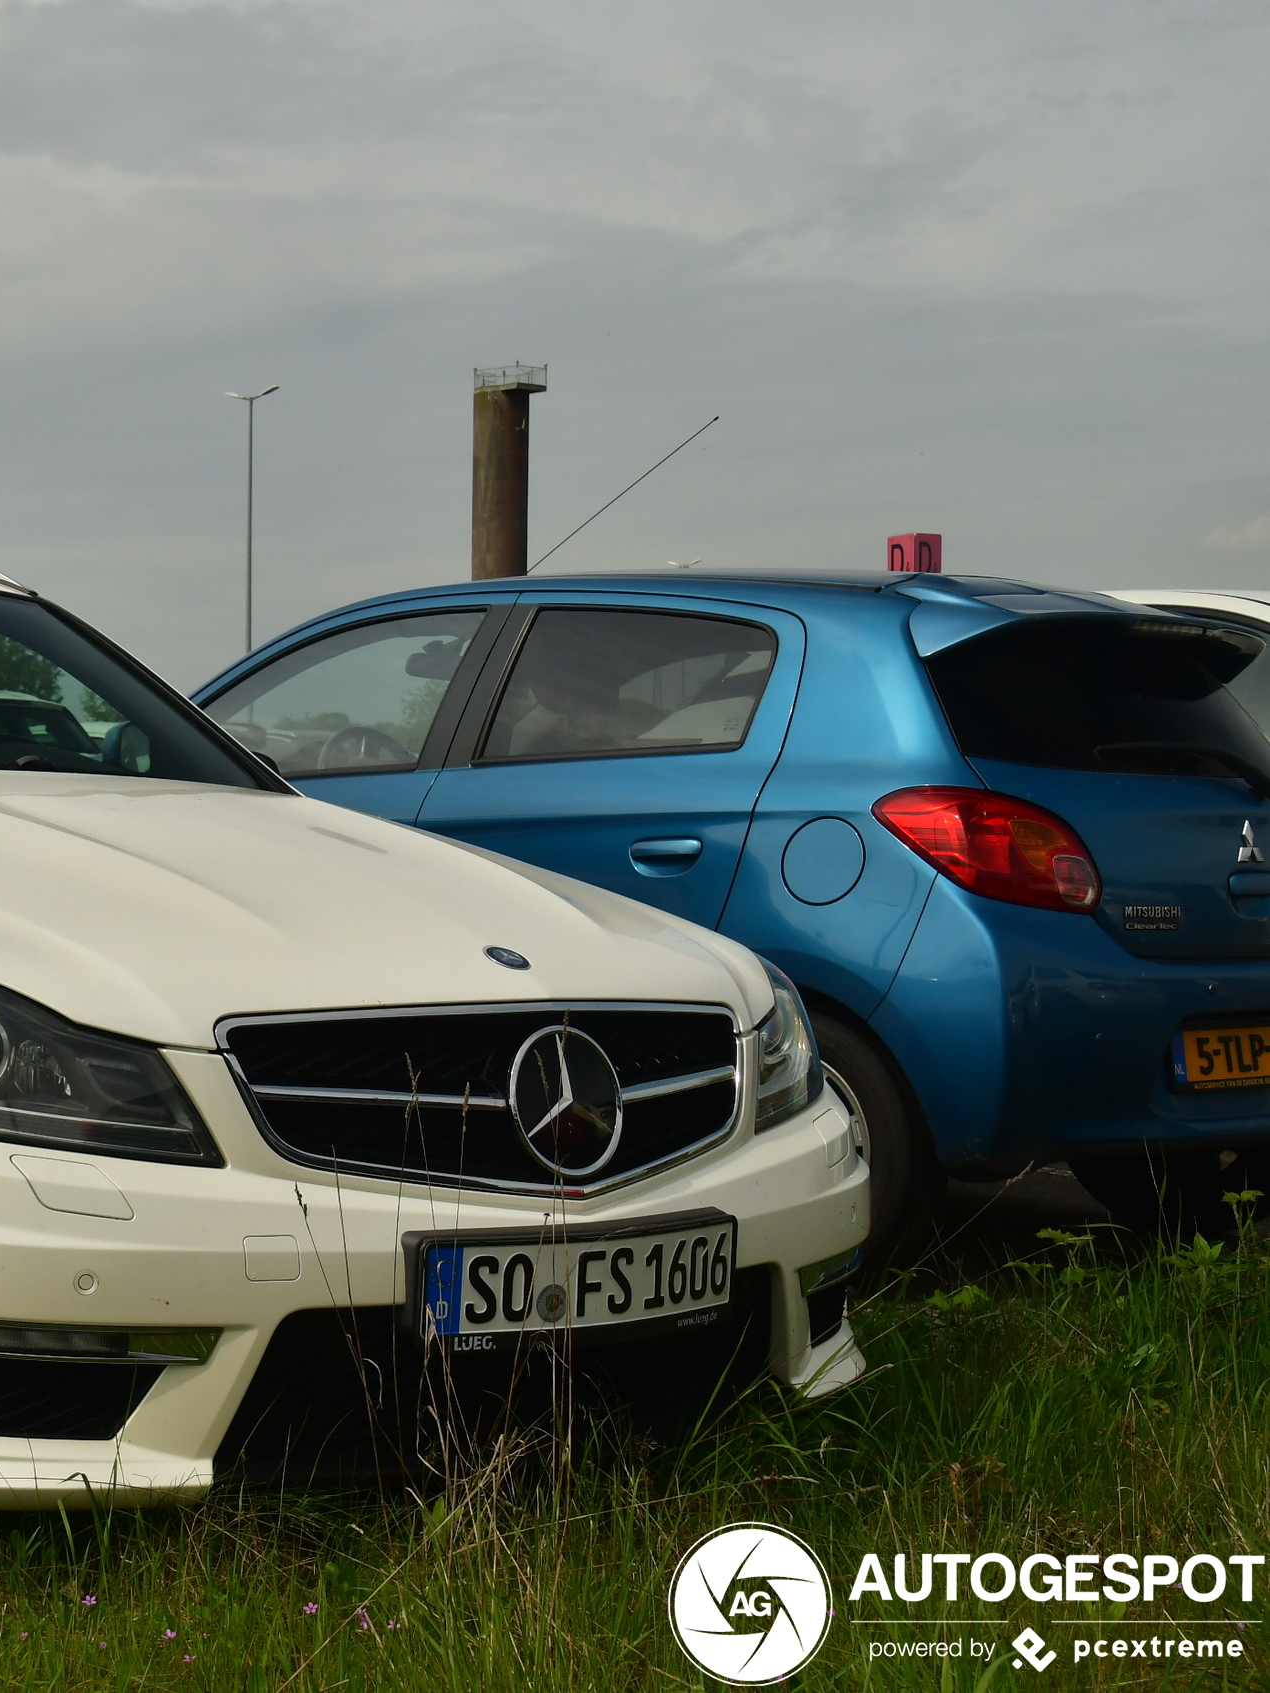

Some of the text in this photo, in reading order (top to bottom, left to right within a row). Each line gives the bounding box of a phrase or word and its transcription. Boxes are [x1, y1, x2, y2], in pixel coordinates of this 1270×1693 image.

[1124, 906, 1181, 918] MITSUBISHI
[1174, 1063, 1186, 1075] NL
[465, 1253, 534, 1324] SO
[436, 1300, 448, 1319] D
